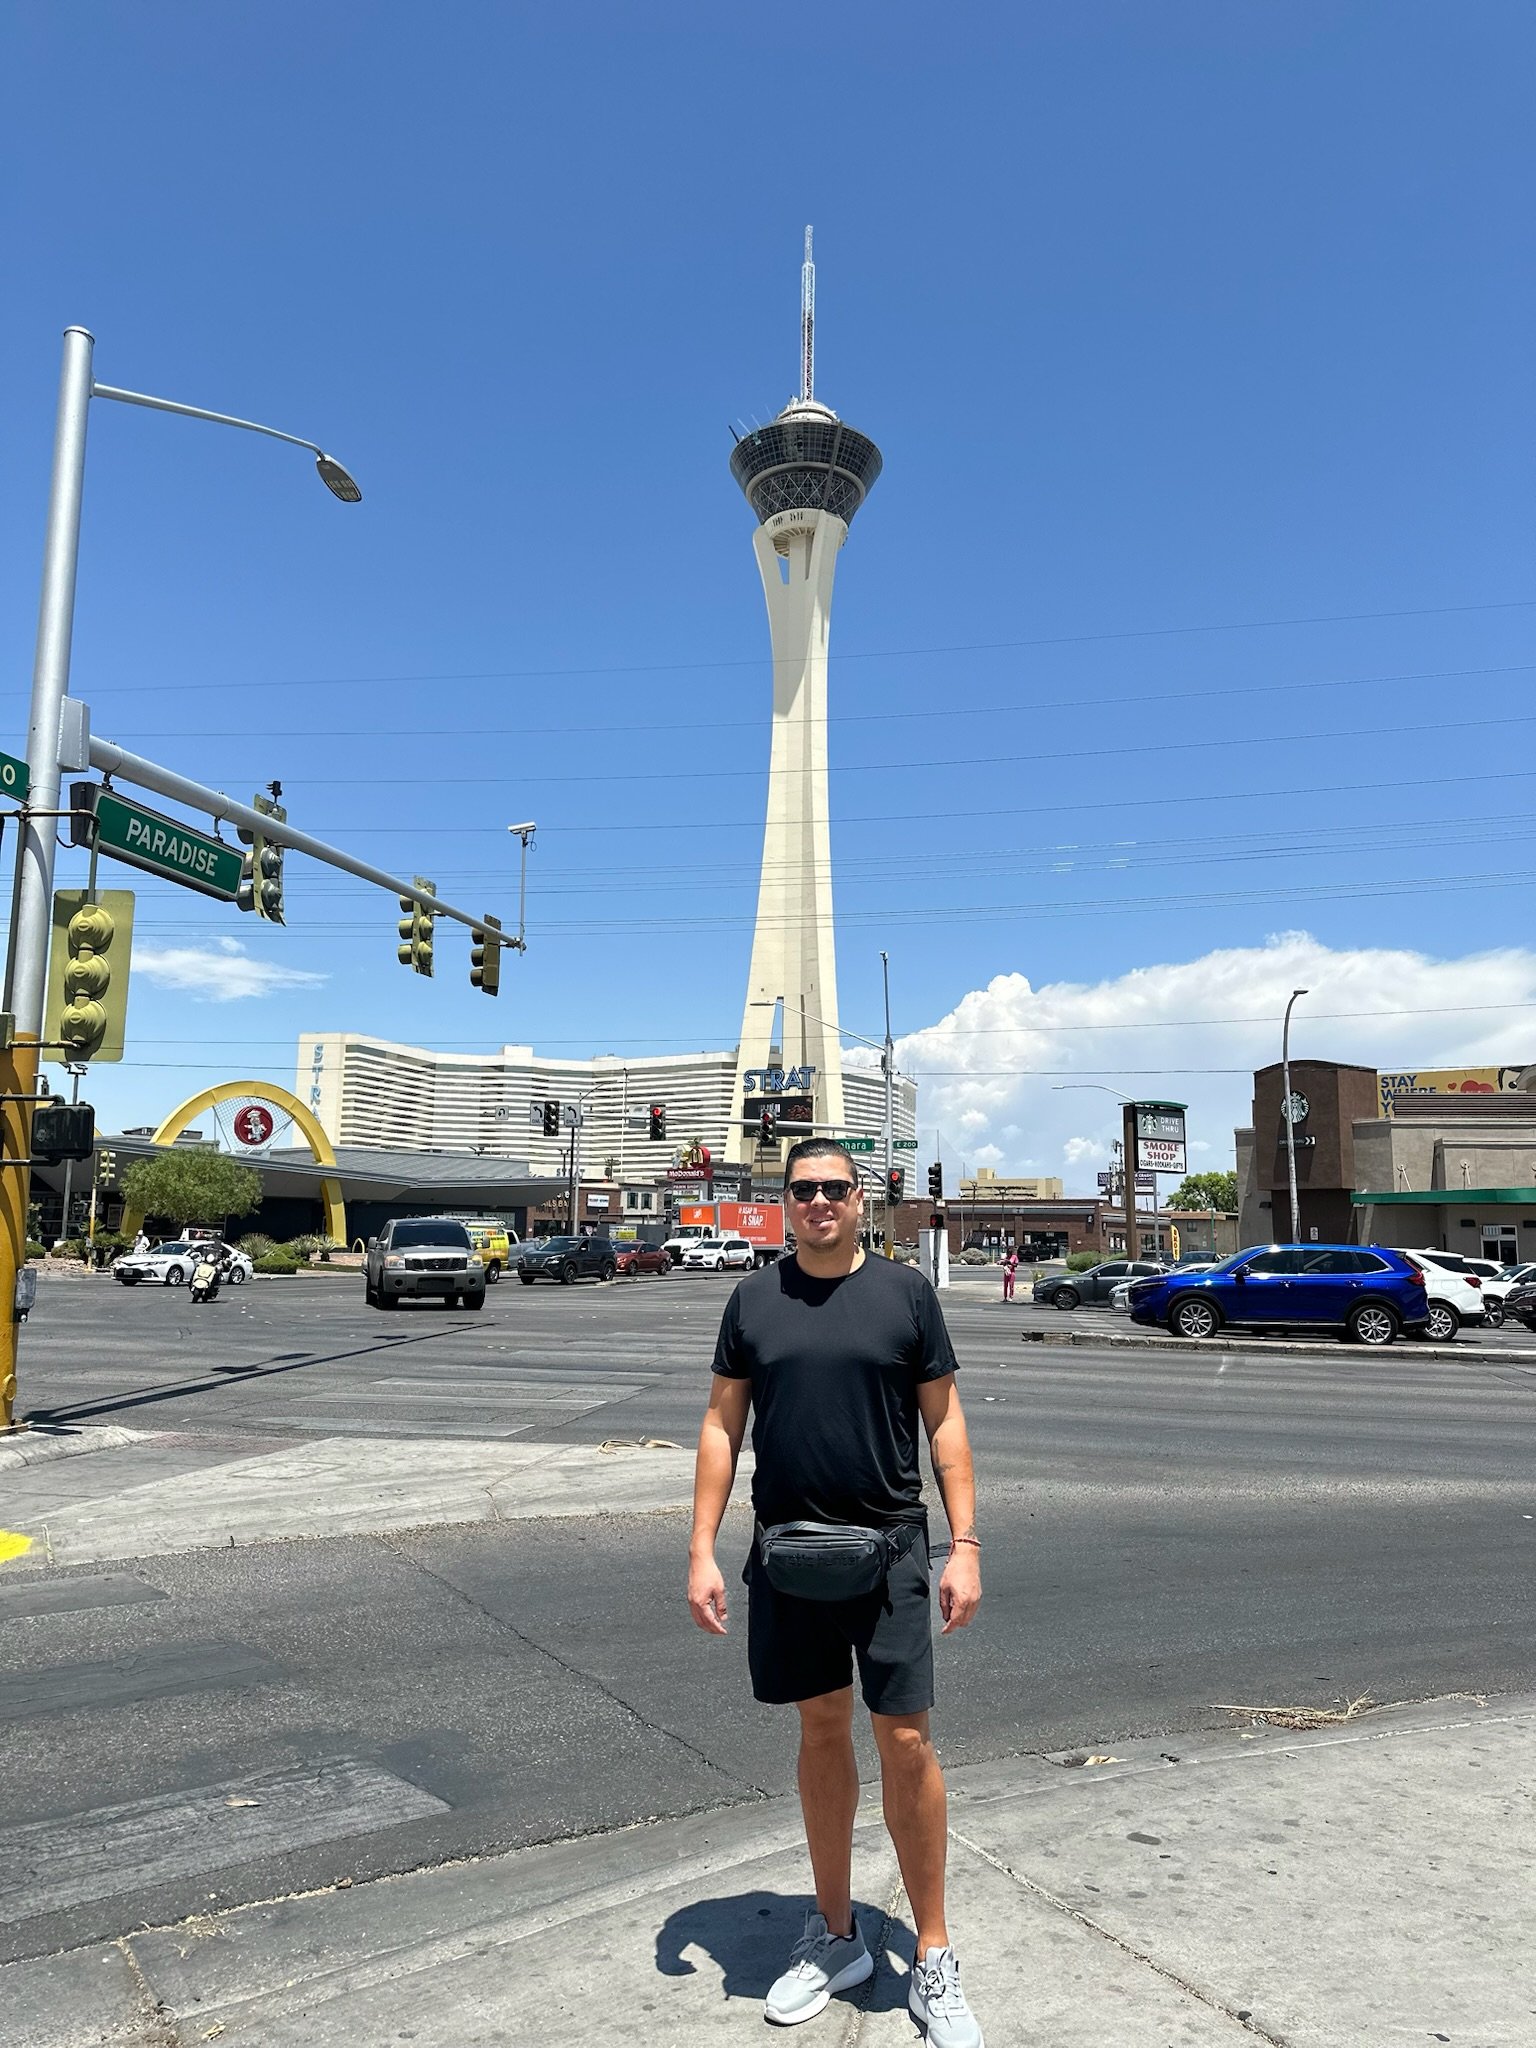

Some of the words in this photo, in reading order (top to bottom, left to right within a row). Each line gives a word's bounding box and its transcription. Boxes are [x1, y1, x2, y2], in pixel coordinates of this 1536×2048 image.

[126, 817, 218, 877] PARADISE
[743, 1065, 816, 1092] STRAT
[1381, 1075, 1417, 1088] STAY
[1160, 1117, 1179, 1125] DRIVE
[840, 1141, 867, 1150] hara
[1143, 1141, 1180, 1152] SMOKE
[1147, 1151, 1176, 1161] SHOP
